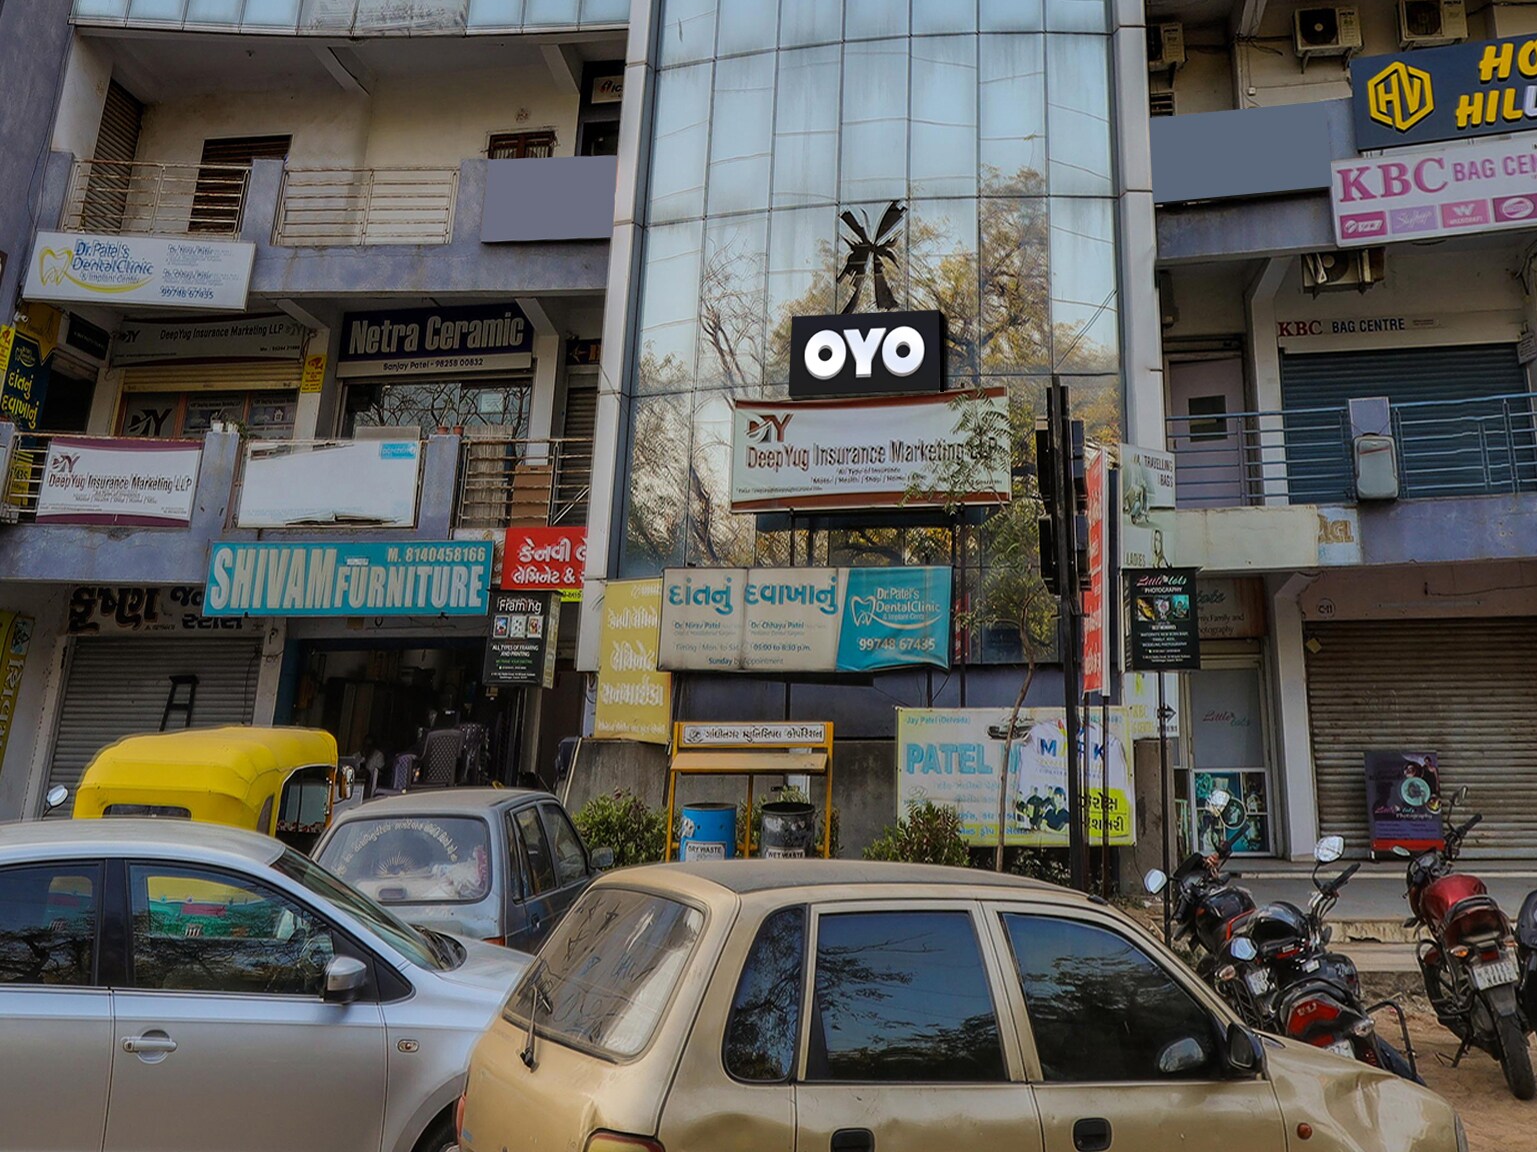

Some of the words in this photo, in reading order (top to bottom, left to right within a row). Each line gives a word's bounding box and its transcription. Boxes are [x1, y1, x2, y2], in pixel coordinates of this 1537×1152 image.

[1336, 157, 1449, 204] KBC
[1453, 158, 1497, 182] BAG
[160, 328, 192, 341] DeepYug
[193, 326, 229, 339] Insurance
[230, 325, 267, 338] Marketing
[269, 323, 284, 335] LLP
[350, 320, 419, 355] Netra
[425, 312, 524, 349] Ceramic
[1278, 320, 1323, 336] KBC
[1332, 320, 1356, 334] BAG
[1359, 318, 1405, 332] CENTRE
[803, 325, 926, 379] OYO
[384, 362, 409, 373] Sanjay
[410, 360, 430, 370] Patel
[746, 445, 810, 473] DeepYug
[812, 442, 886, 467] Insurance
[889, 438, 964, 464] Marketing
[88, 473, 130, 490] Insurance
[131, 475, 173, 494] Marketing
[387, 549, 402, 563] M.
[404, 547, 486, 563] 8140458166
[210, 547, 338, 610] SHIVAM
[334, 565, 485, 609] FURNITURE
[564, 570, 575, 583] &
[669, 576, 734, 615] દાંતનું
[744, 576, 839, 615] દવાખાનું
[1144, 586, 1183, 594] PHOTOGRAPHY
[859, 638, 896, 651] 99748
[899, 638, 936, 650] 67435
[708, 658, 733, 666] Sunday
[743, 657, 784, 666] Appointment
[920, 716, 938, 725] Patel
[905, 742, 993, 775] PATEL
